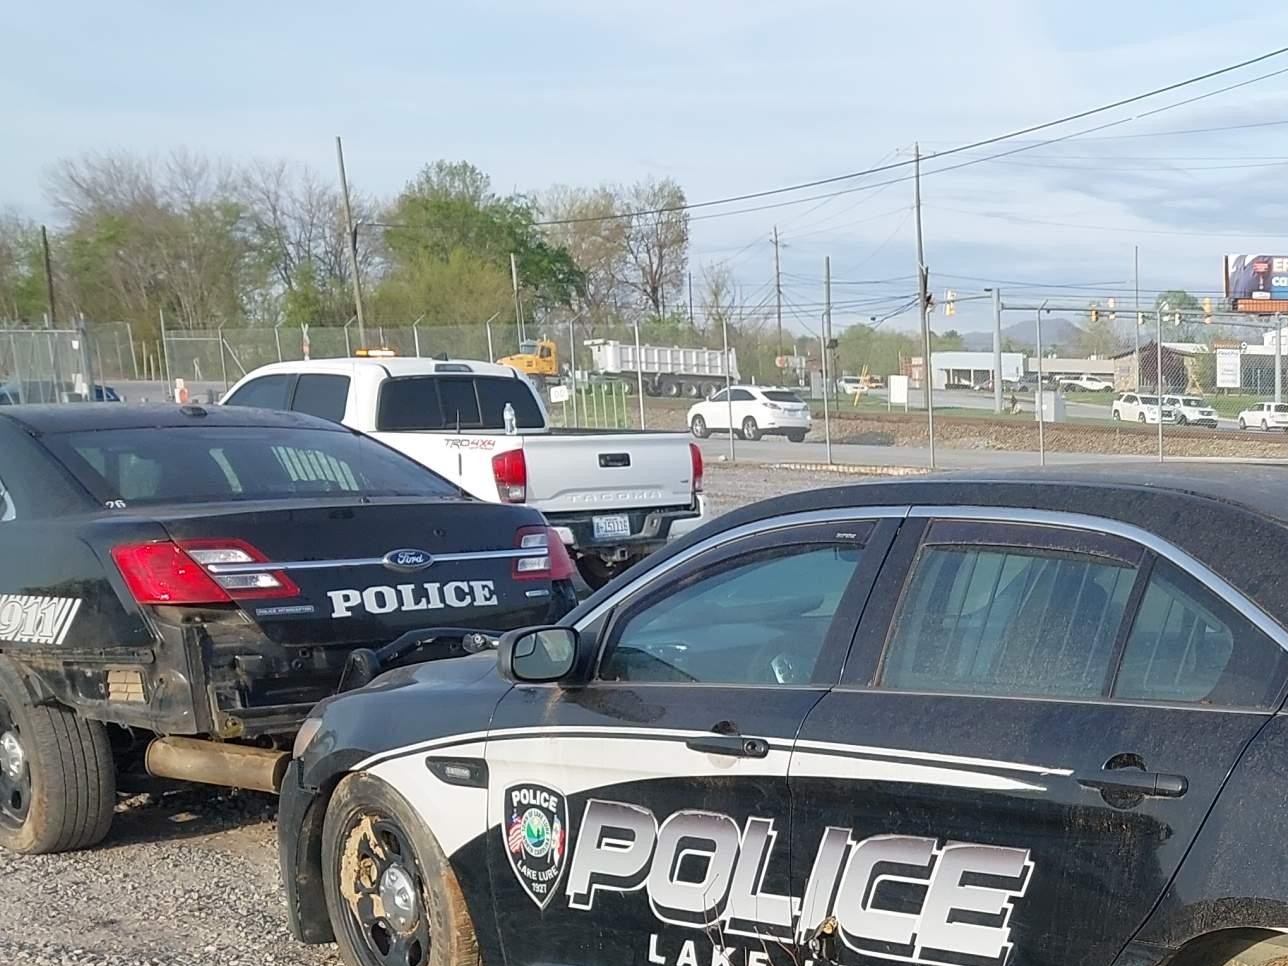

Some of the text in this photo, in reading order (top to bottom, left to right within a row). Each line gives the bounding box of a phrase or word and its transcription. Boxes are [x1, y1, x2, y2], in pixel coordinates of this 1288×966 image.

[396, 551, 425, 565] Ford
[327, 580, 498, 618] POLICE
[0, 600, 57, 637] 911
[511, 788, 559, 813] POLICE
[517, 859, 559, 881] LAKE LURE
